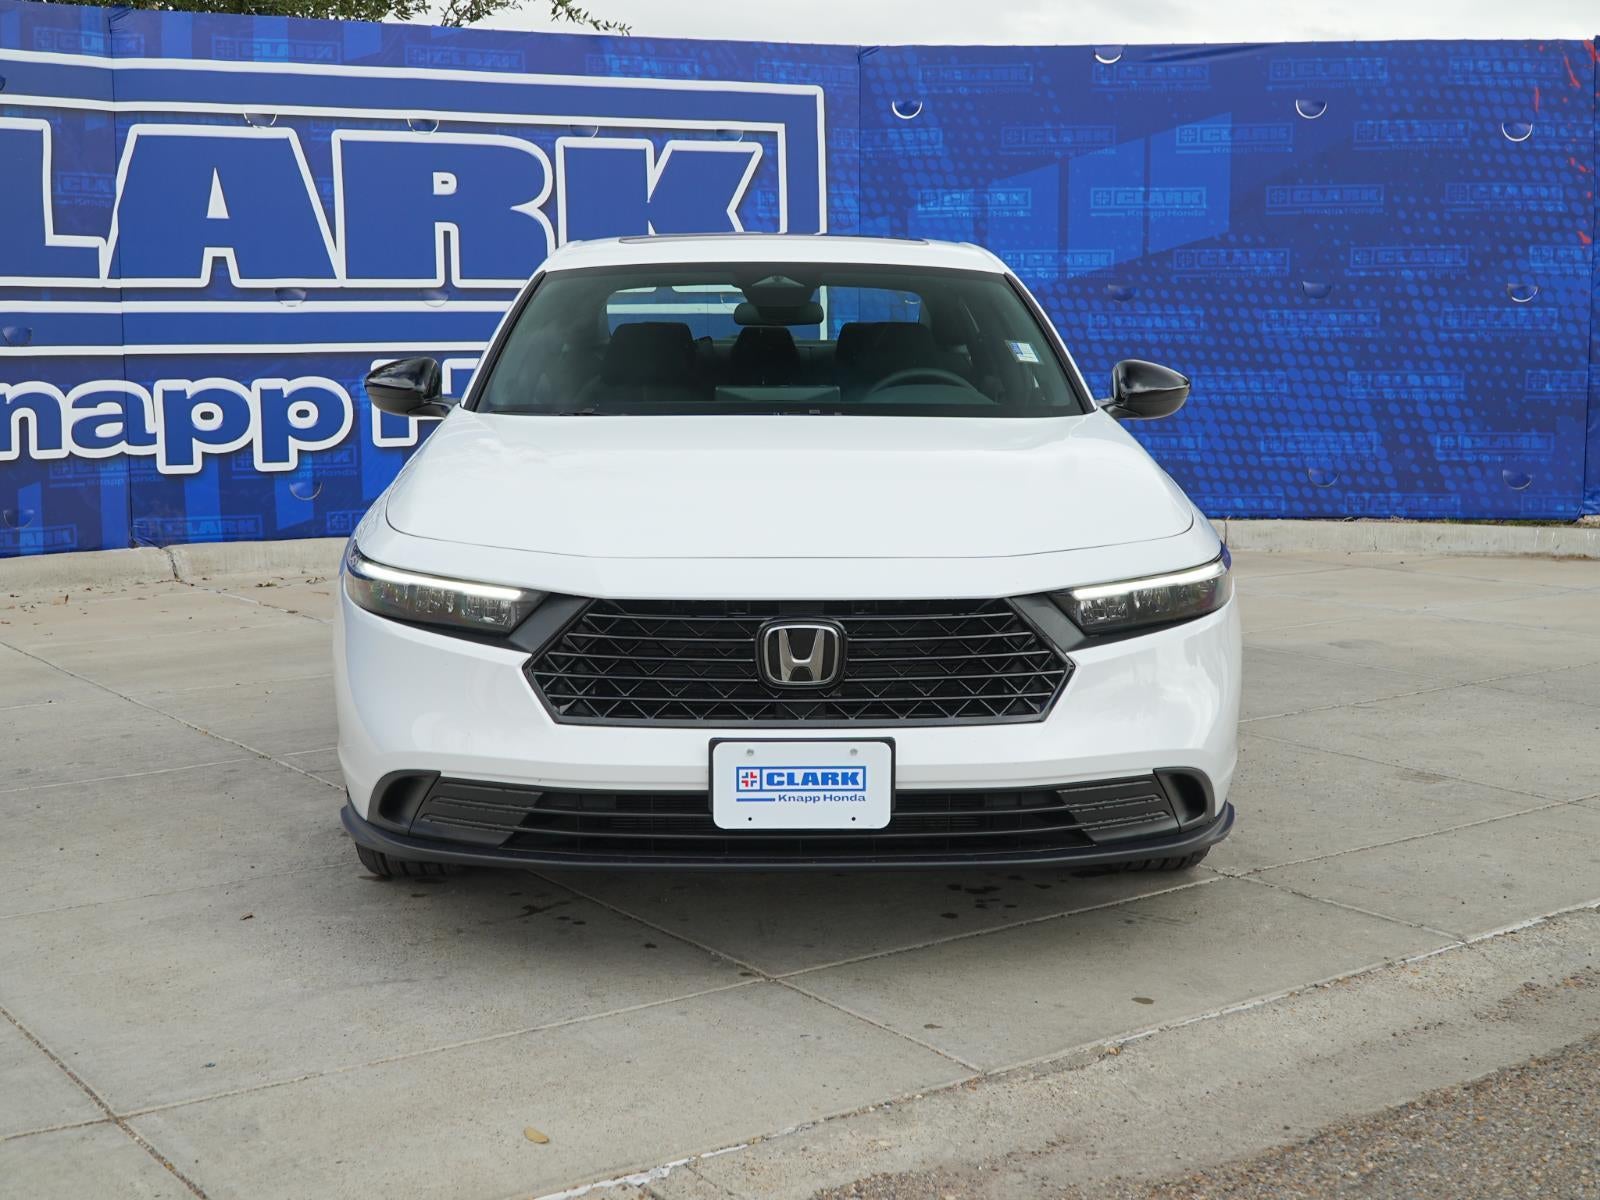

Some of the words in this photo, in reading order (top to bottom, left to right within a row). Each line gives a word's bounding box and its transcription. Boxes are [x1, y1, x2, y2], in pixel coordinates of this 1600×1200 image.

[766, 771, 860, 786] CLARK
[778, 794, 821, 804] Knapp
[823, 794, 866, 802] Honda
